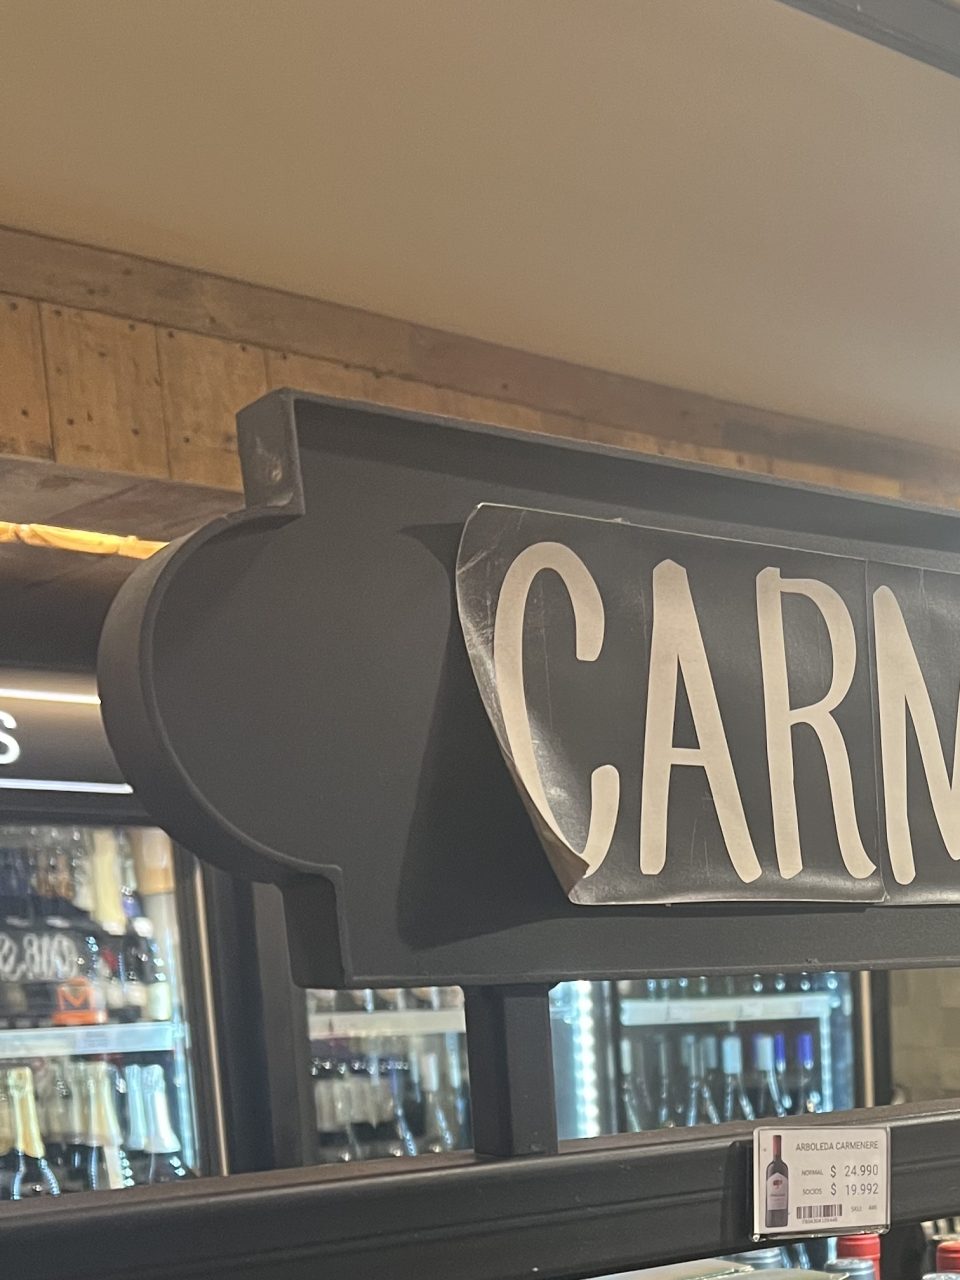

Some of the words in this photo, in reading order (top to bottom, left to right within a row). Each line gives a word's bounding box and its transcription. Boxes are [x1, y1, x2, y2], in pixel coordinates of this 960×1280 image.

[795, 1142, 834, 1152] ARBOLEDA
[835, 1141, 879, 1150] CARMENERE
[830, 1164, 837, 1178] $
[844, 1164, 879, 1178] 24.990
[831, 1182, 837, 1196] $
[845, 1183, 879, 1196] 19.992
